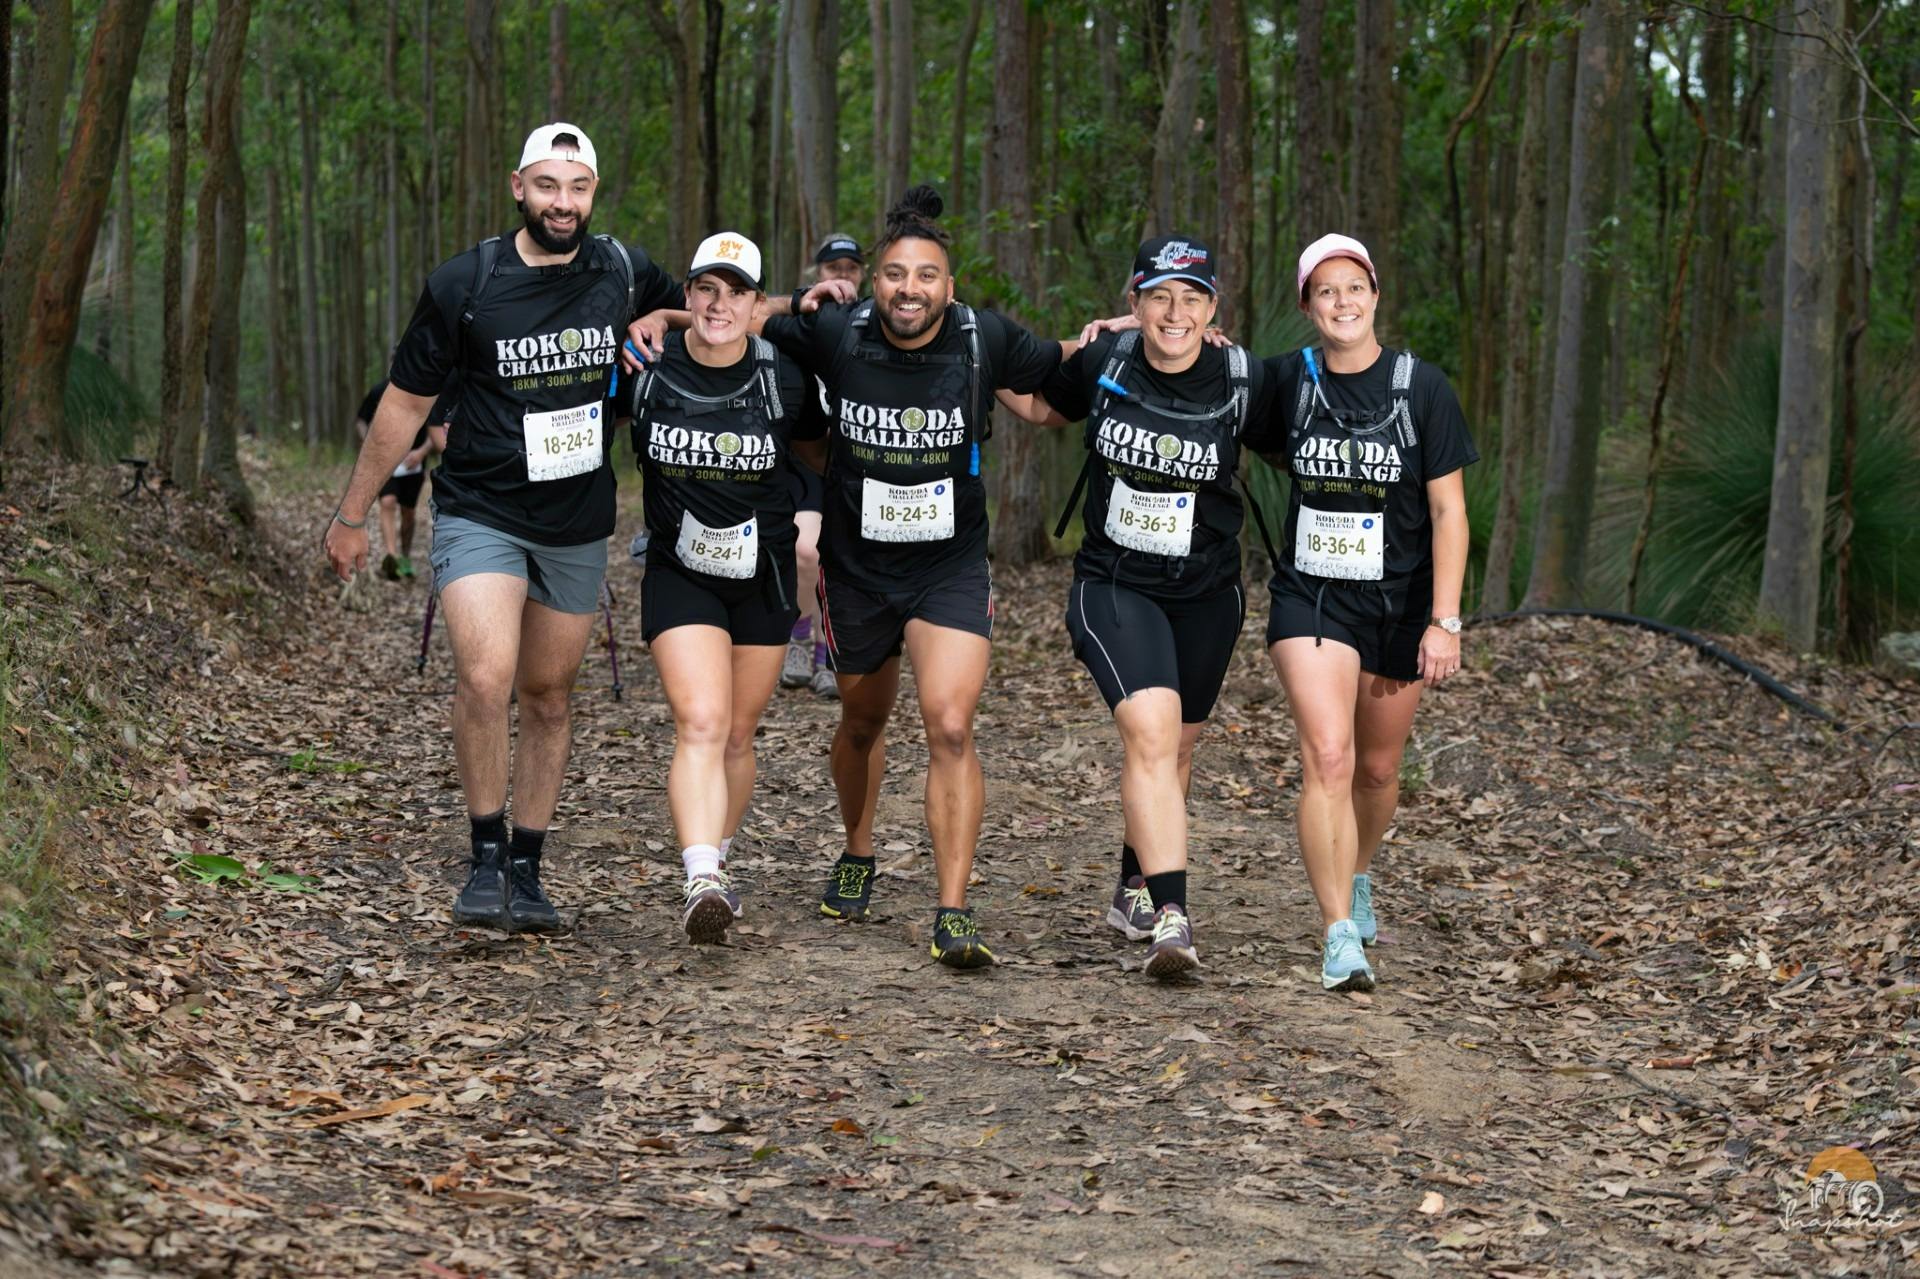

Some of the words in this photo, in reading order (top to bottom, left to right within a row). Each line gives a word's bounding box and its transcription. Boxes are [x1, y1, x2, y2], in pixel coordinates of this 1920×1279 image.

[497, 348, 616, 378] CHALLENGE
[512, 377, 539, 391] 18KM
[546, 374, 573, 388] 30KM
[543, 428, 594, 455] 18-24-2
[839, 421, 965, 449] CHALLENGE
[648, 444, 776, 471] CHALLENGE
[851, 444, 875, 461] 18KM
[883, 451, 913, 465] 30KM
[921, 451, 950, 465] 48KM
[1096, 437, 1219, 481] CHALLENGE
[695, 469, 725, 481] 30KM
[1134, 470, 1163, 485] 30KM
[1324, 481, 1352, 494] 30KM
[1360, 483, 1387, 499] 48KM
[879, 504, 937, 522] 18-24-3
[1119, 507, 1177, 533] 18-36-3
[690, 539, 744, 561] 18-24-1
[1307, 532, 1366, 556] 18-36-4
